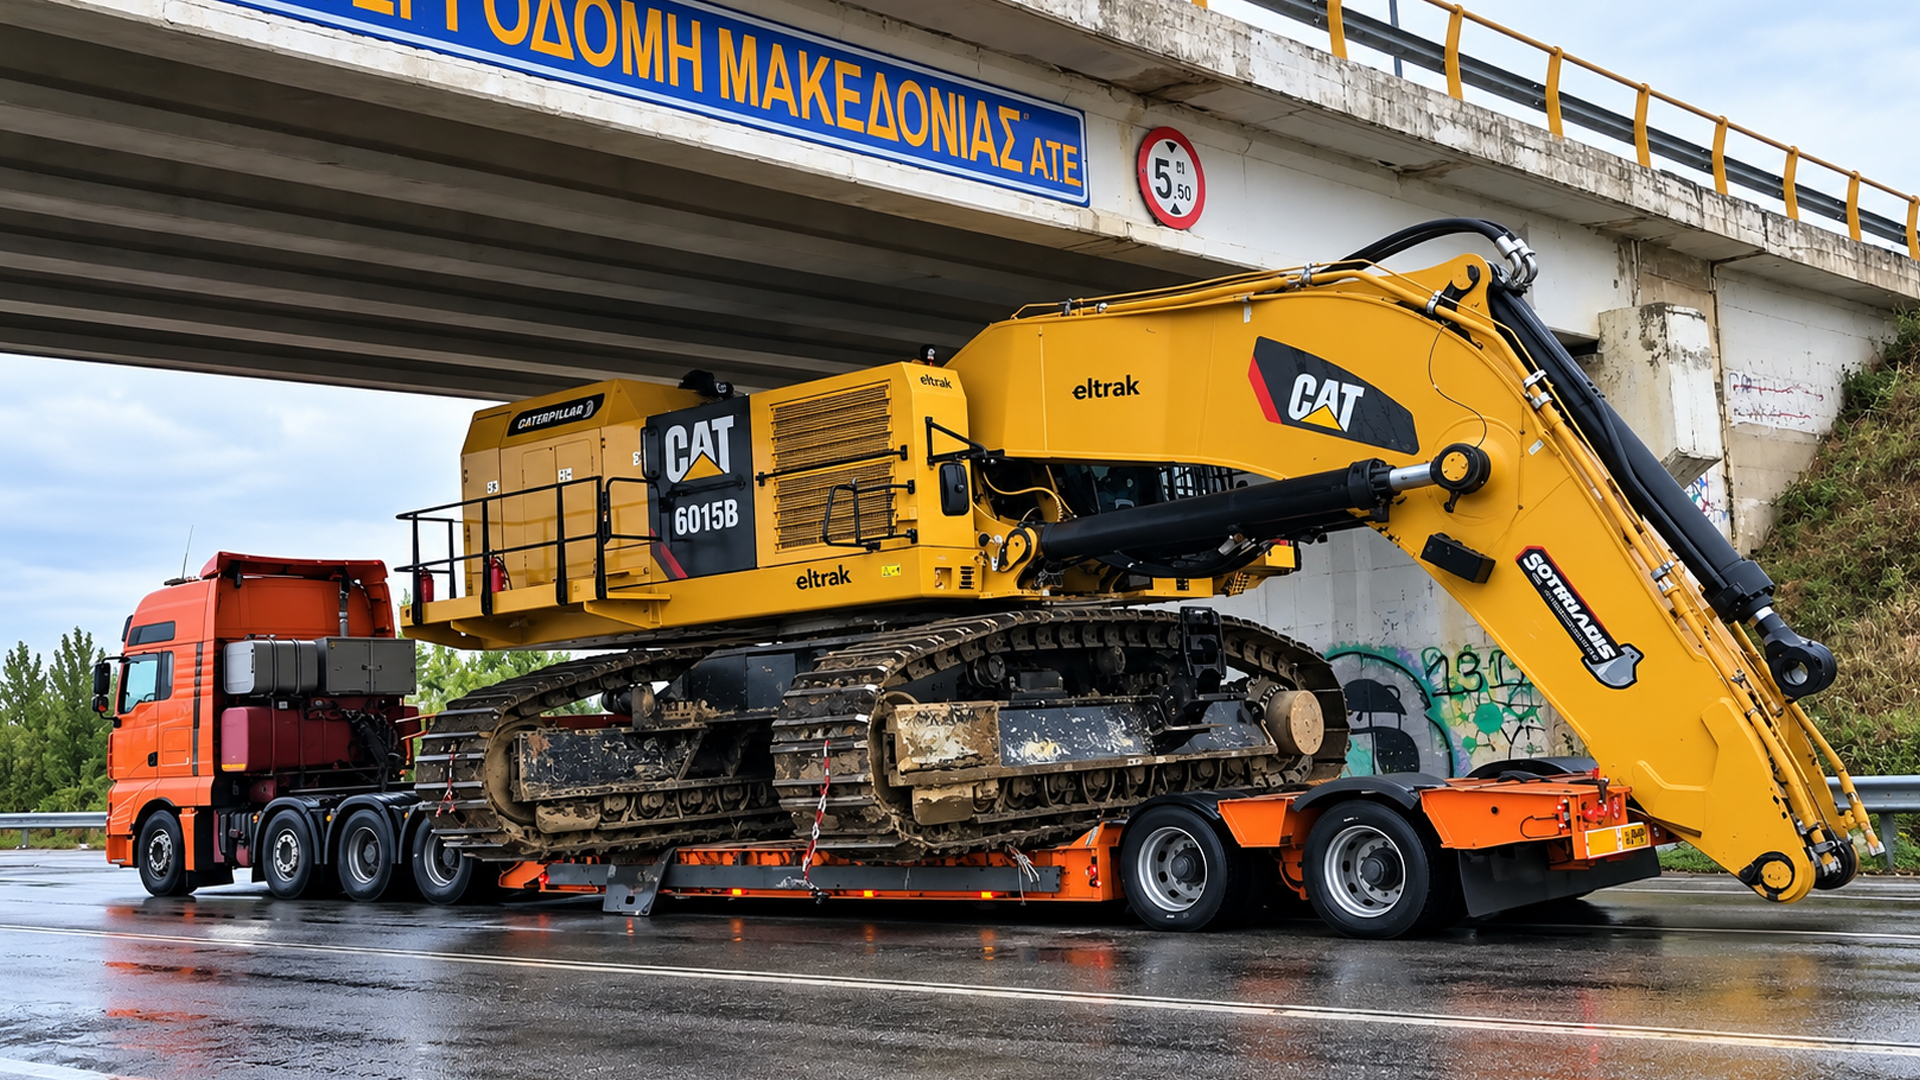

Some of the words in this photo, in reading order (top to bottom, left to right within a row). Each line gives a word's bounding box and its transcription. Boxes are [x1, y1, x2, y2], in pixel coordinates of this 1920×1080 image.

[352, 0, 703, 93] ΟΔΟΜΗ
[718, 27, 1023, 173] ΜΑΚΕΔΟΝΙΑΣ
[920, 374, 952, 389] eltrak
[1072, 374, 1140, 400] eltrak
[517, 404, 584, 430] CATERPILLAR
[1288, 373, 1365, 432] CAT
[665, 415, 734, 483] CAT
[675, 499, 739, 535] 6015B
[795, 564, 852, 590] eltrak
